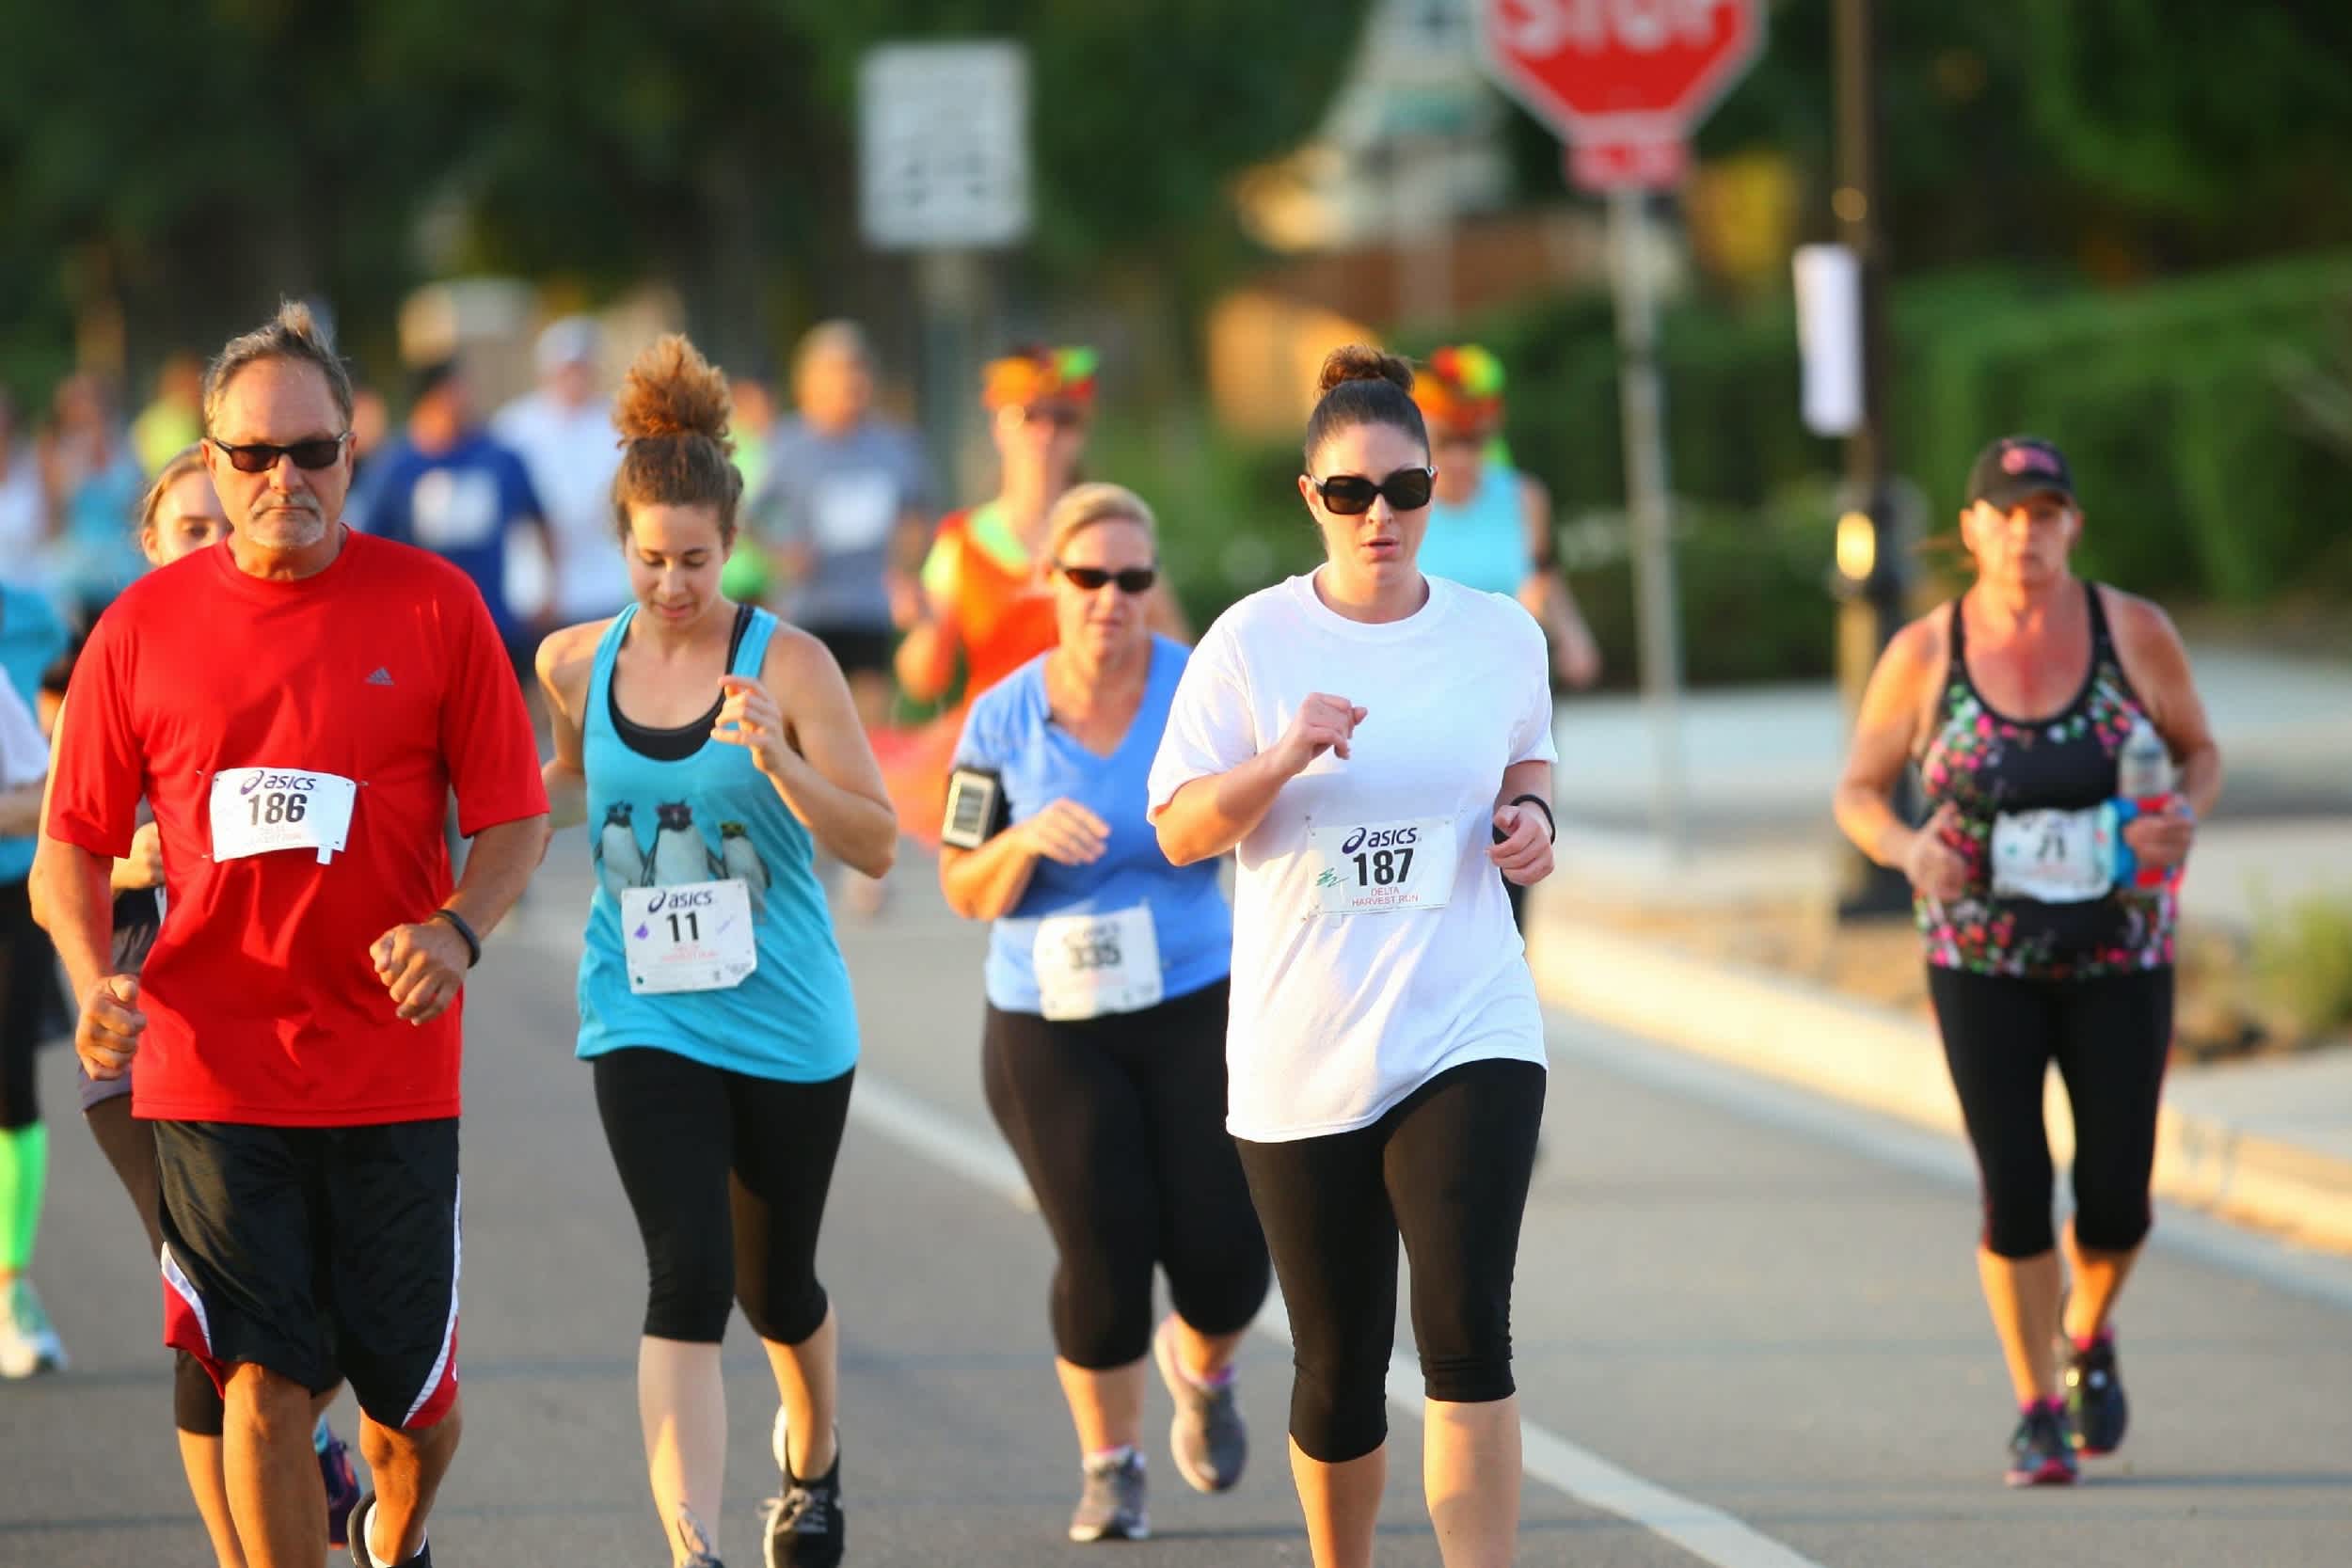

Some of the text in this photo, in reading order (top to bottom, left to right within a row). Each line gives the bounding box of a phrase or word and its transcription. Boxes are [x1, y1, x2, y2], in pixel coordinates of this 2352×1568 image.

[264, 774, 316, 791] asics
[247, 792, 308, 826] 186
[1367, 828, 1418, 847] asics
[1353, 848, 1414, 886] 187
[669, 891, 712, 909] asics
[1371, 887, 1400, 896] DELTA
[1352, 895, 1419, 907] HARVEST RUN
[666, 911, 699, 943] 11
